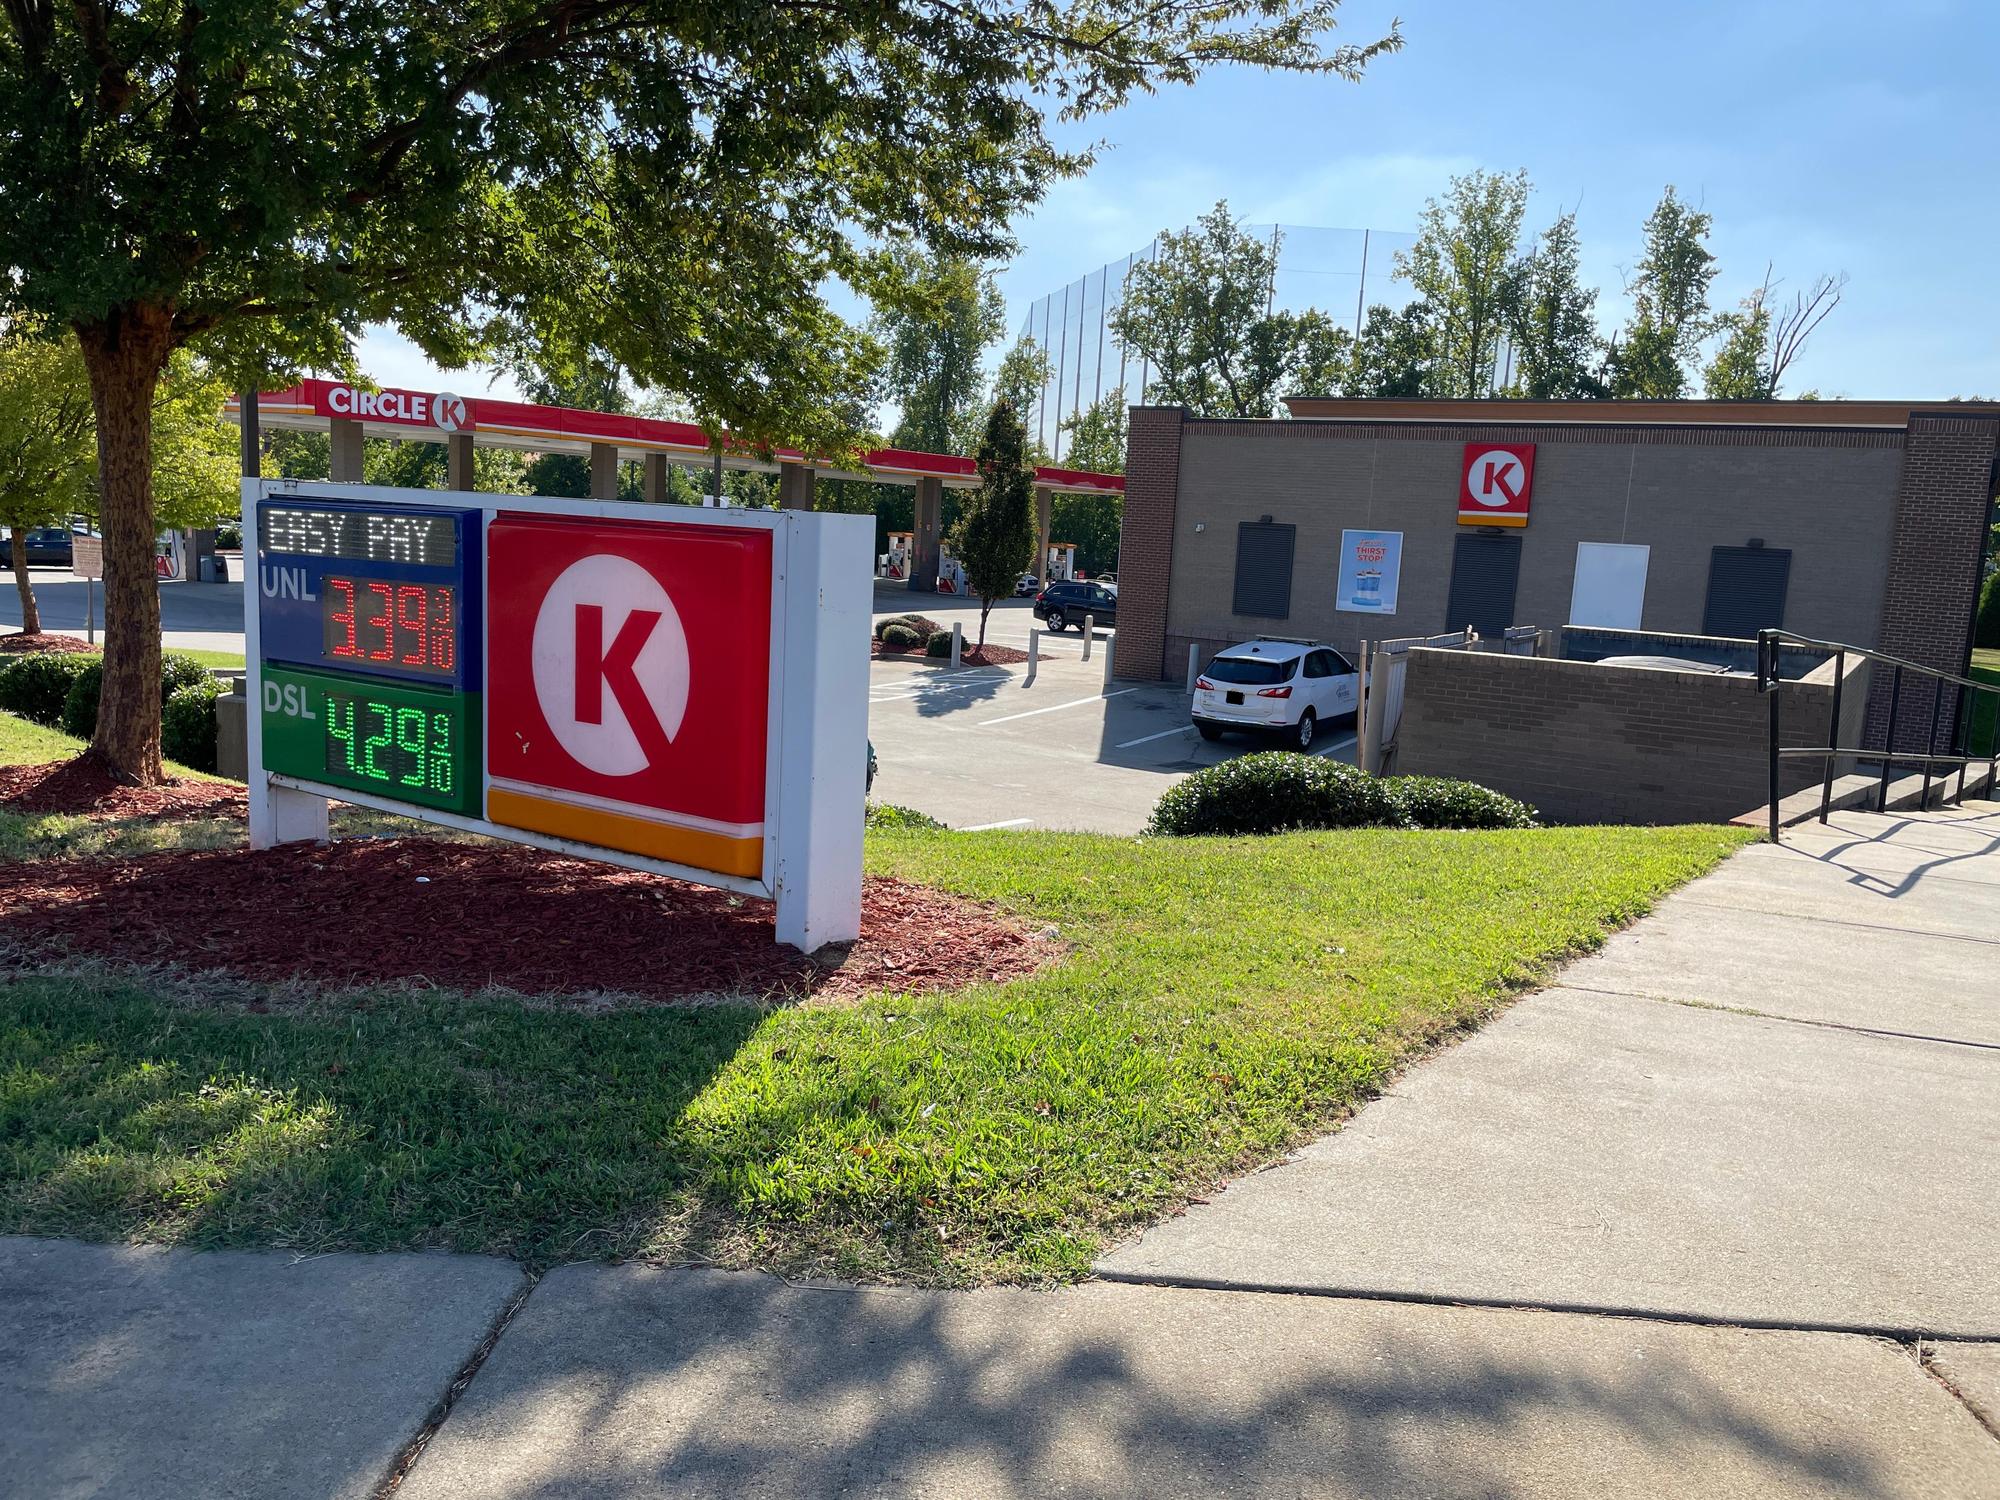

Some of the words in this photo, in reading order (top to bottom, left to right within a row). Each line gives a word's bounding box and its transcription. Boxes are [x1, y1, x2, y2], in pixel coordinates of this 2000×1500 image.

[328, 387, 426, 421] CIRCLE
[268, 509, 346, 555] EASY
[367, 515, 433, 562] PAY
[1356, 546, 1387, 555] THIRST
[261, 565, 316, 602] UNL
[263, 680, 316, 720] DSL
